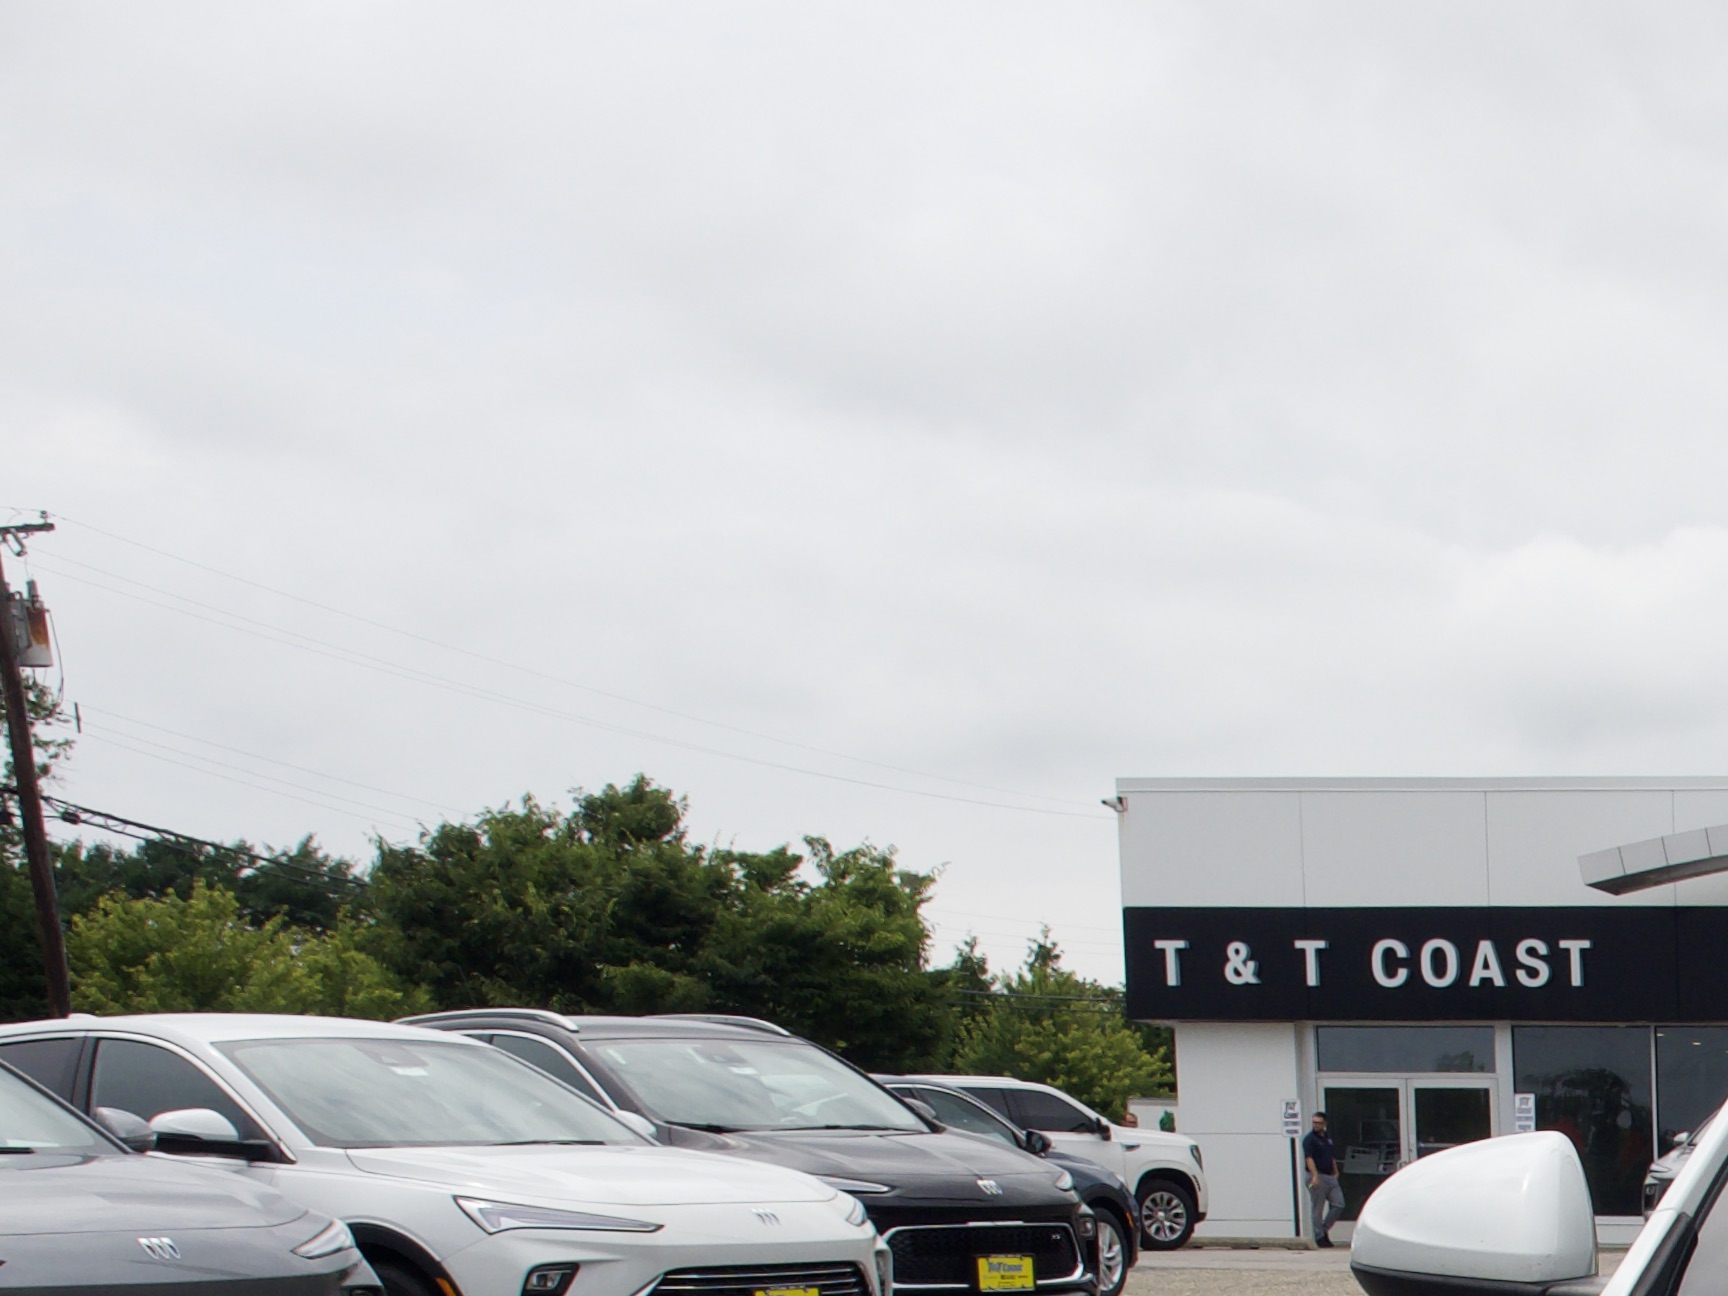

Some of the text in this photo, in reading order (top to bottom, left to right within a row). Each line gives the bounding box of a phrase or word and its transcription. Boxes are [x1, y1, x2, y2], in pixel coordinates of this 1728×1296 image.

[1154, 937, 1594, 988] T & T COAST
